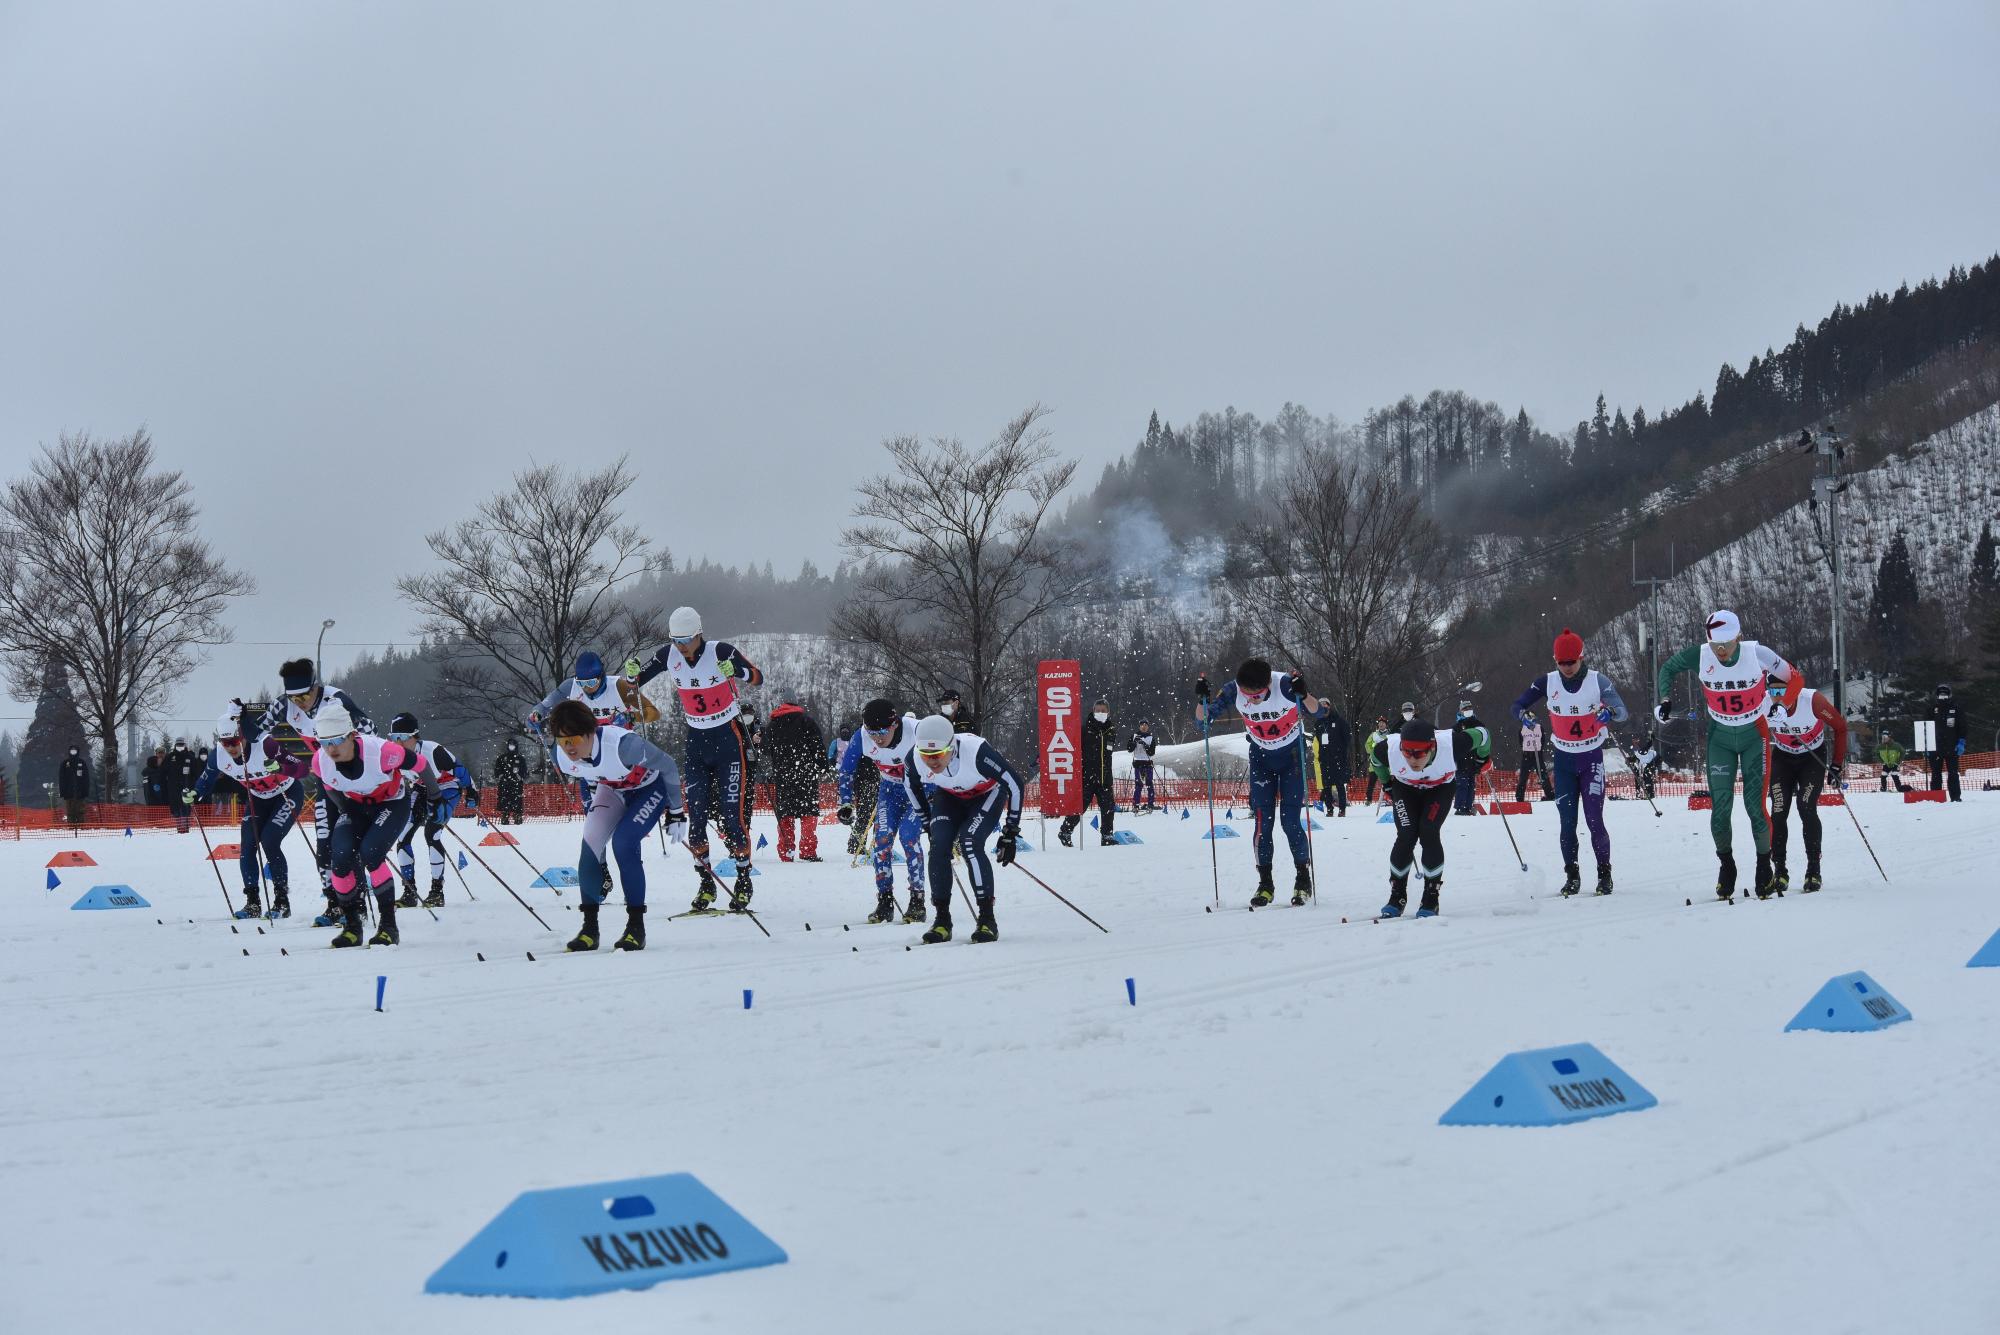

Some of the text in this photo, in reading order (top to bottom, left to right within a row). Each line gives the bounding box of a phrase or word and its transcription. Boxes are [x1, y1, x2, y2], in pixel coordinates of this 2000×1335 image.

[692, 693, 707, 713] 3
[1717, 694, 1744, 713] 15
[1046, 686, 1075, 795] START
[1569, 720, 1583, 737] 4
[727, 761, 740, 803] HOSEI
[1772, 782, 1784, 813] WASEDA
[315, 799, 330, 839] TOYO
[632, 791, 664, 825] TOKAI
[1394, 799, 1411, 827] SENSHU
[1548, 1077, 1627, 1112] KAZUNO
[581, 1222, 729, 1273] KAZUNO
